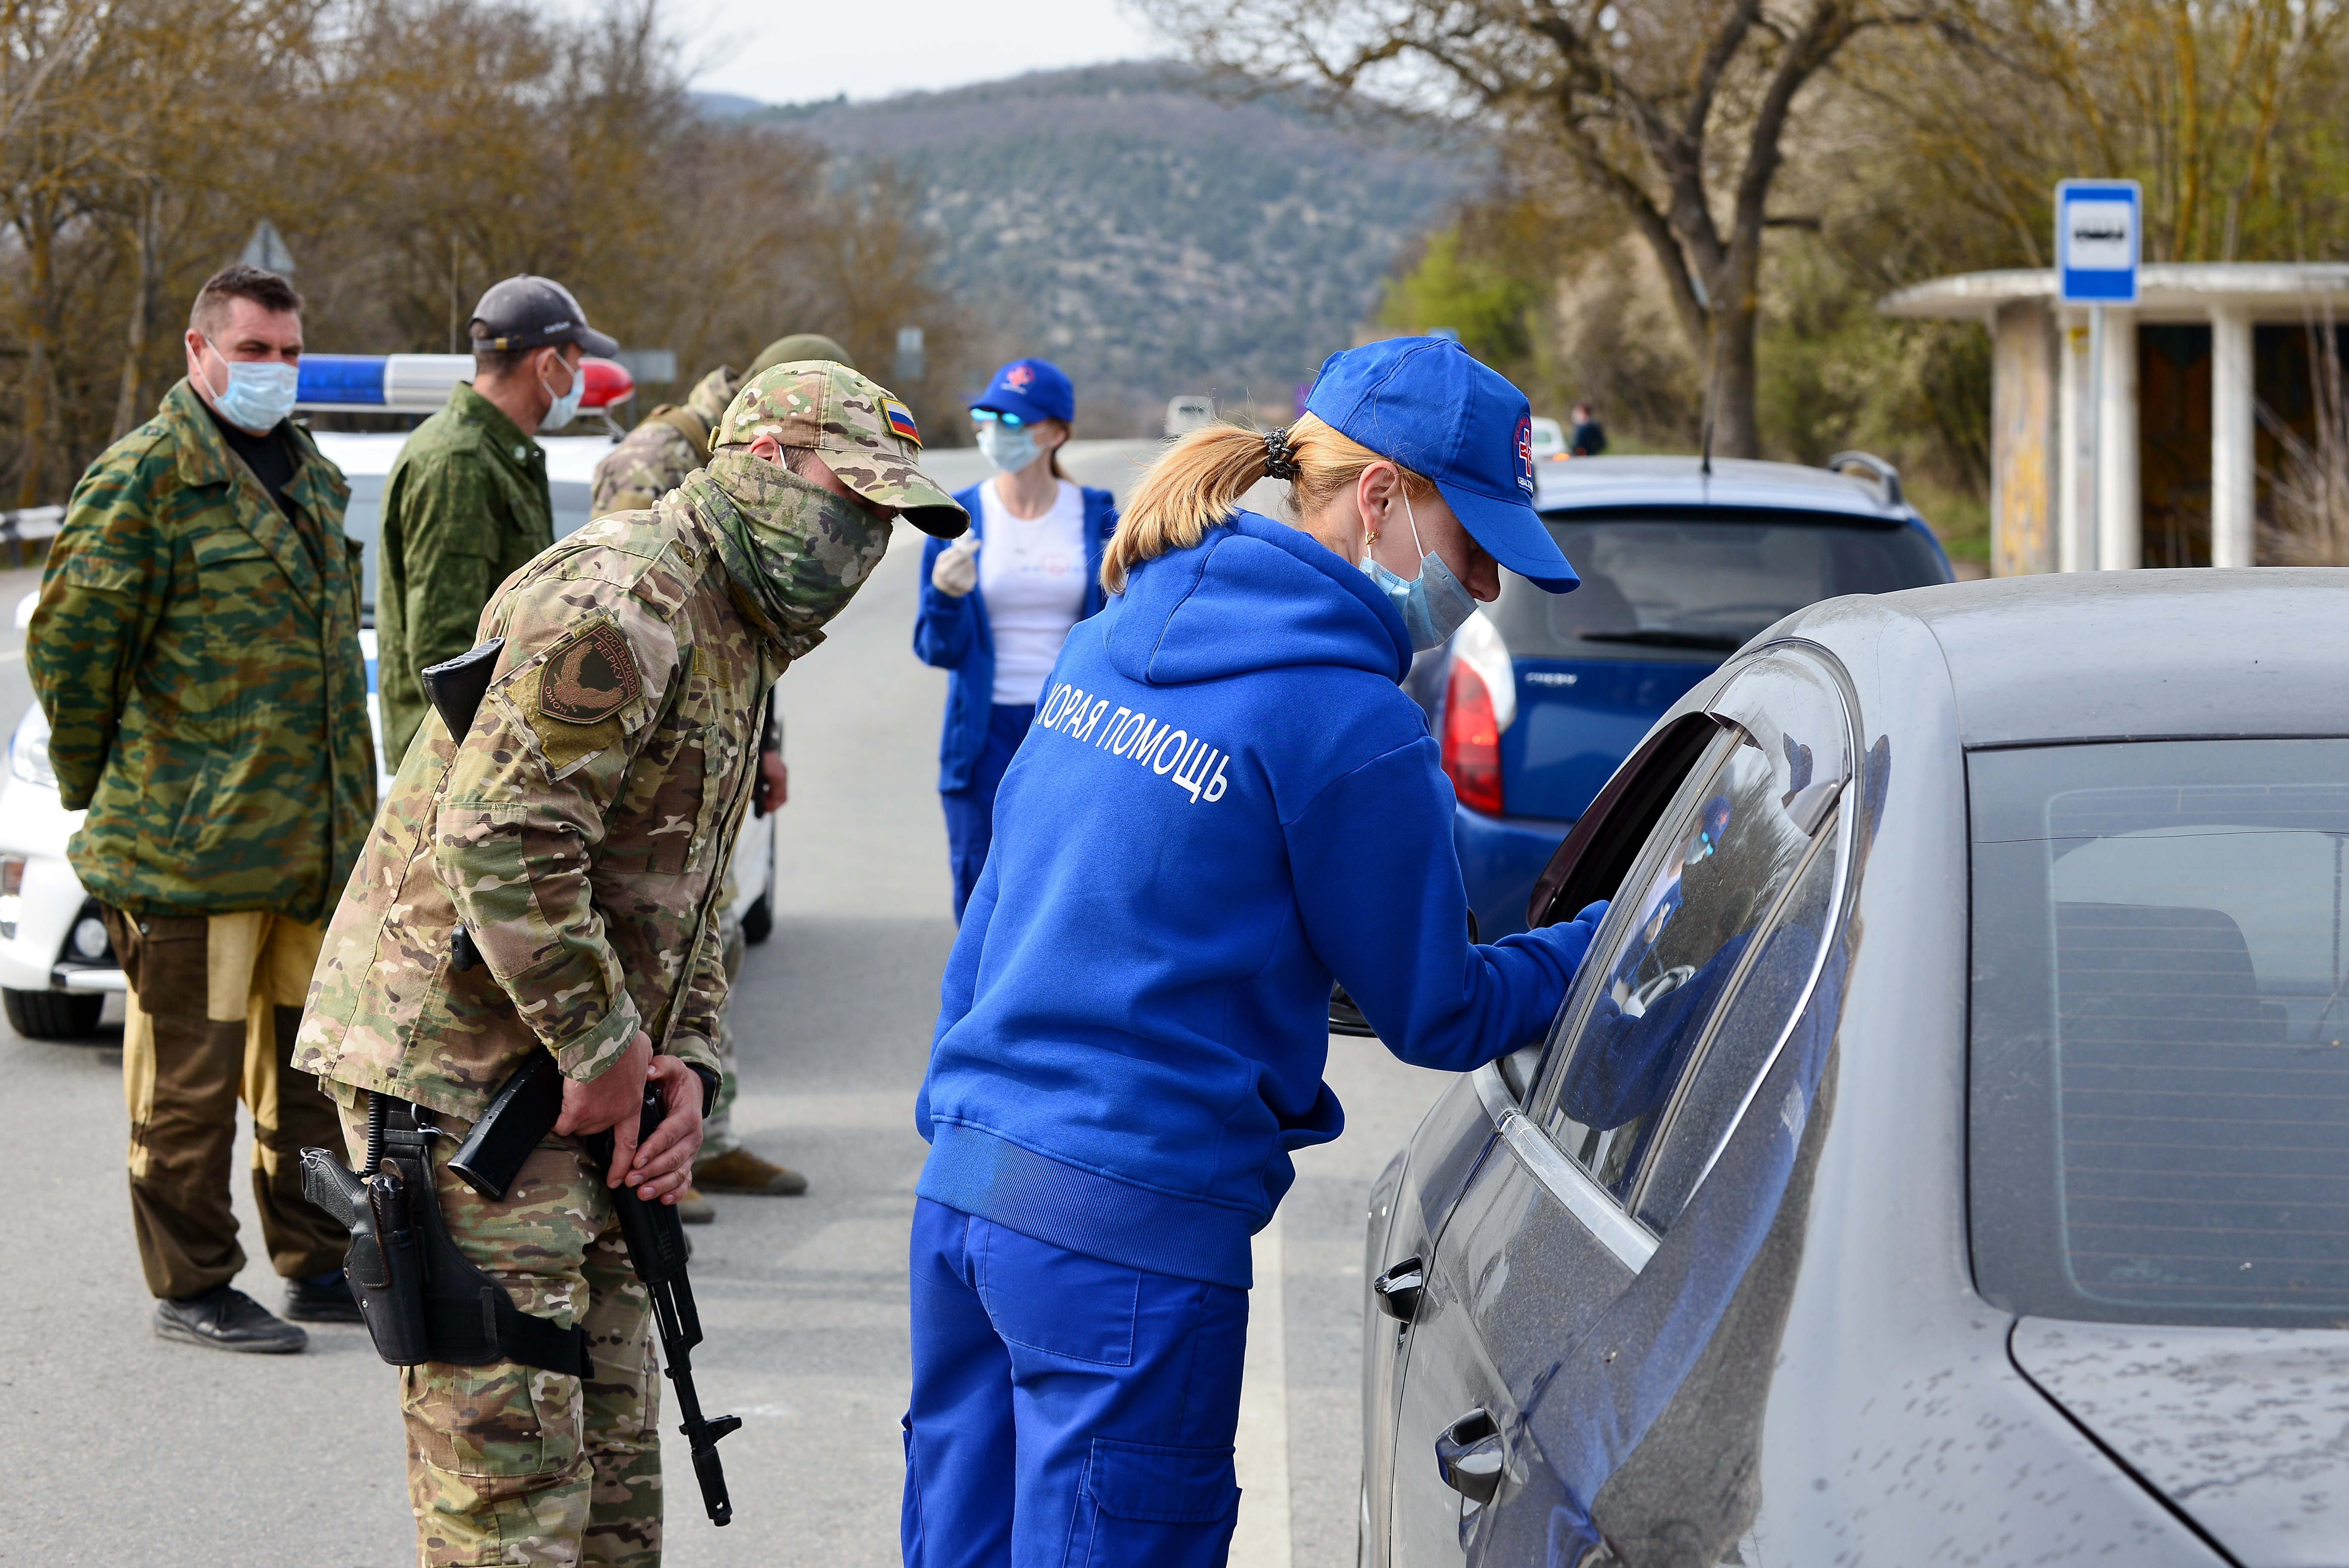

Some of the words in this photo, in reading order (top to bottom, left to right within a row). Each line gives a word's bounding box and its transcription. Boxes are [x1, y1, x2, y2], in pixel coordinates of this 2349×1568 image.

[594, 641, 626, 688] БЕРКУТ
[598, 629, 636, 693] РОСГВАРДИЯ
[545, 686, 567, 714] ОМОН
[1035, 682, 1110, 742] КОРАЯ
[1095, 706, 1230, 804] ПОМОЩЬ
